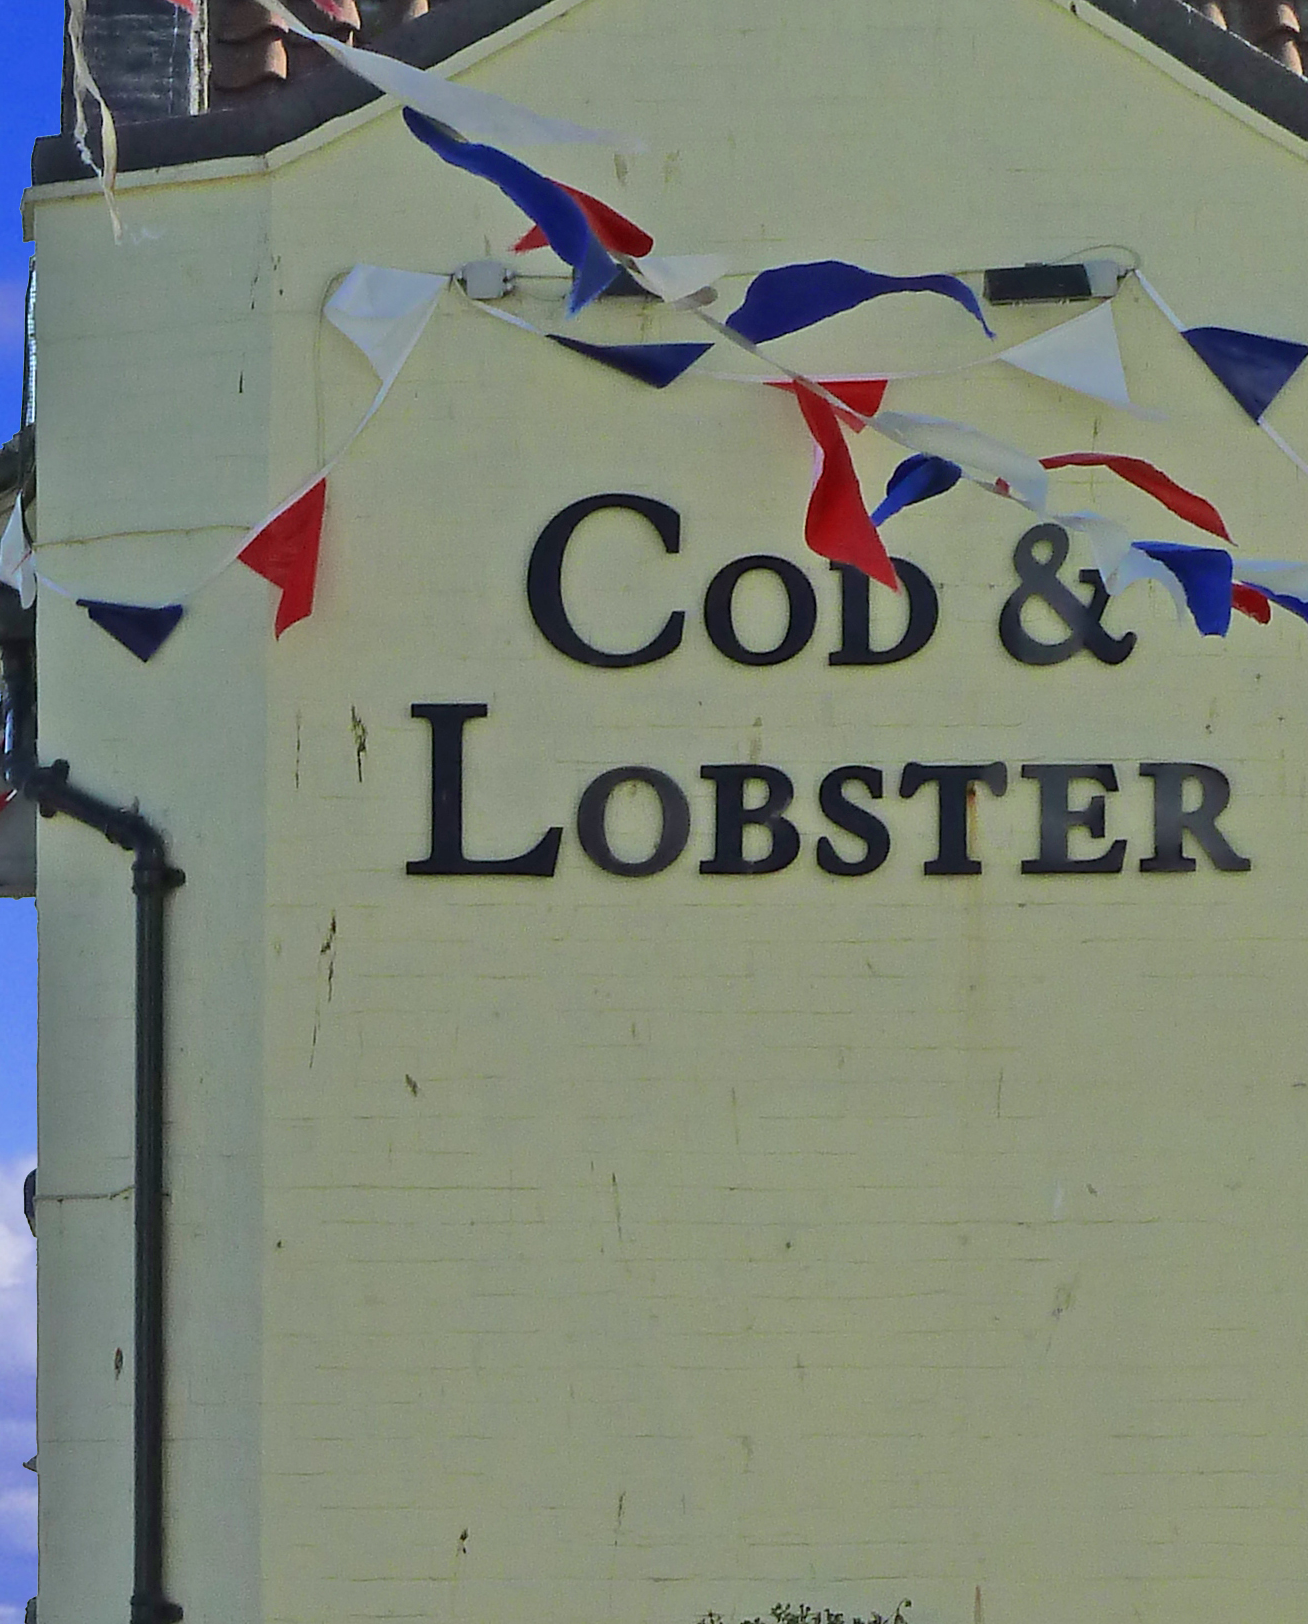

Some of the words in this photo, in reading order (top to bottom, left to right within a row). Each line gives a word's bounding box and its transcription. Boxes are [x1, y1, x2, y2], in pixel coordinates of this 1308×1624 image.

[527, 493, 939, 667] COD
[998, 522, 1136, 665] &
[406, 703, 1251, 878] LOBSTER
